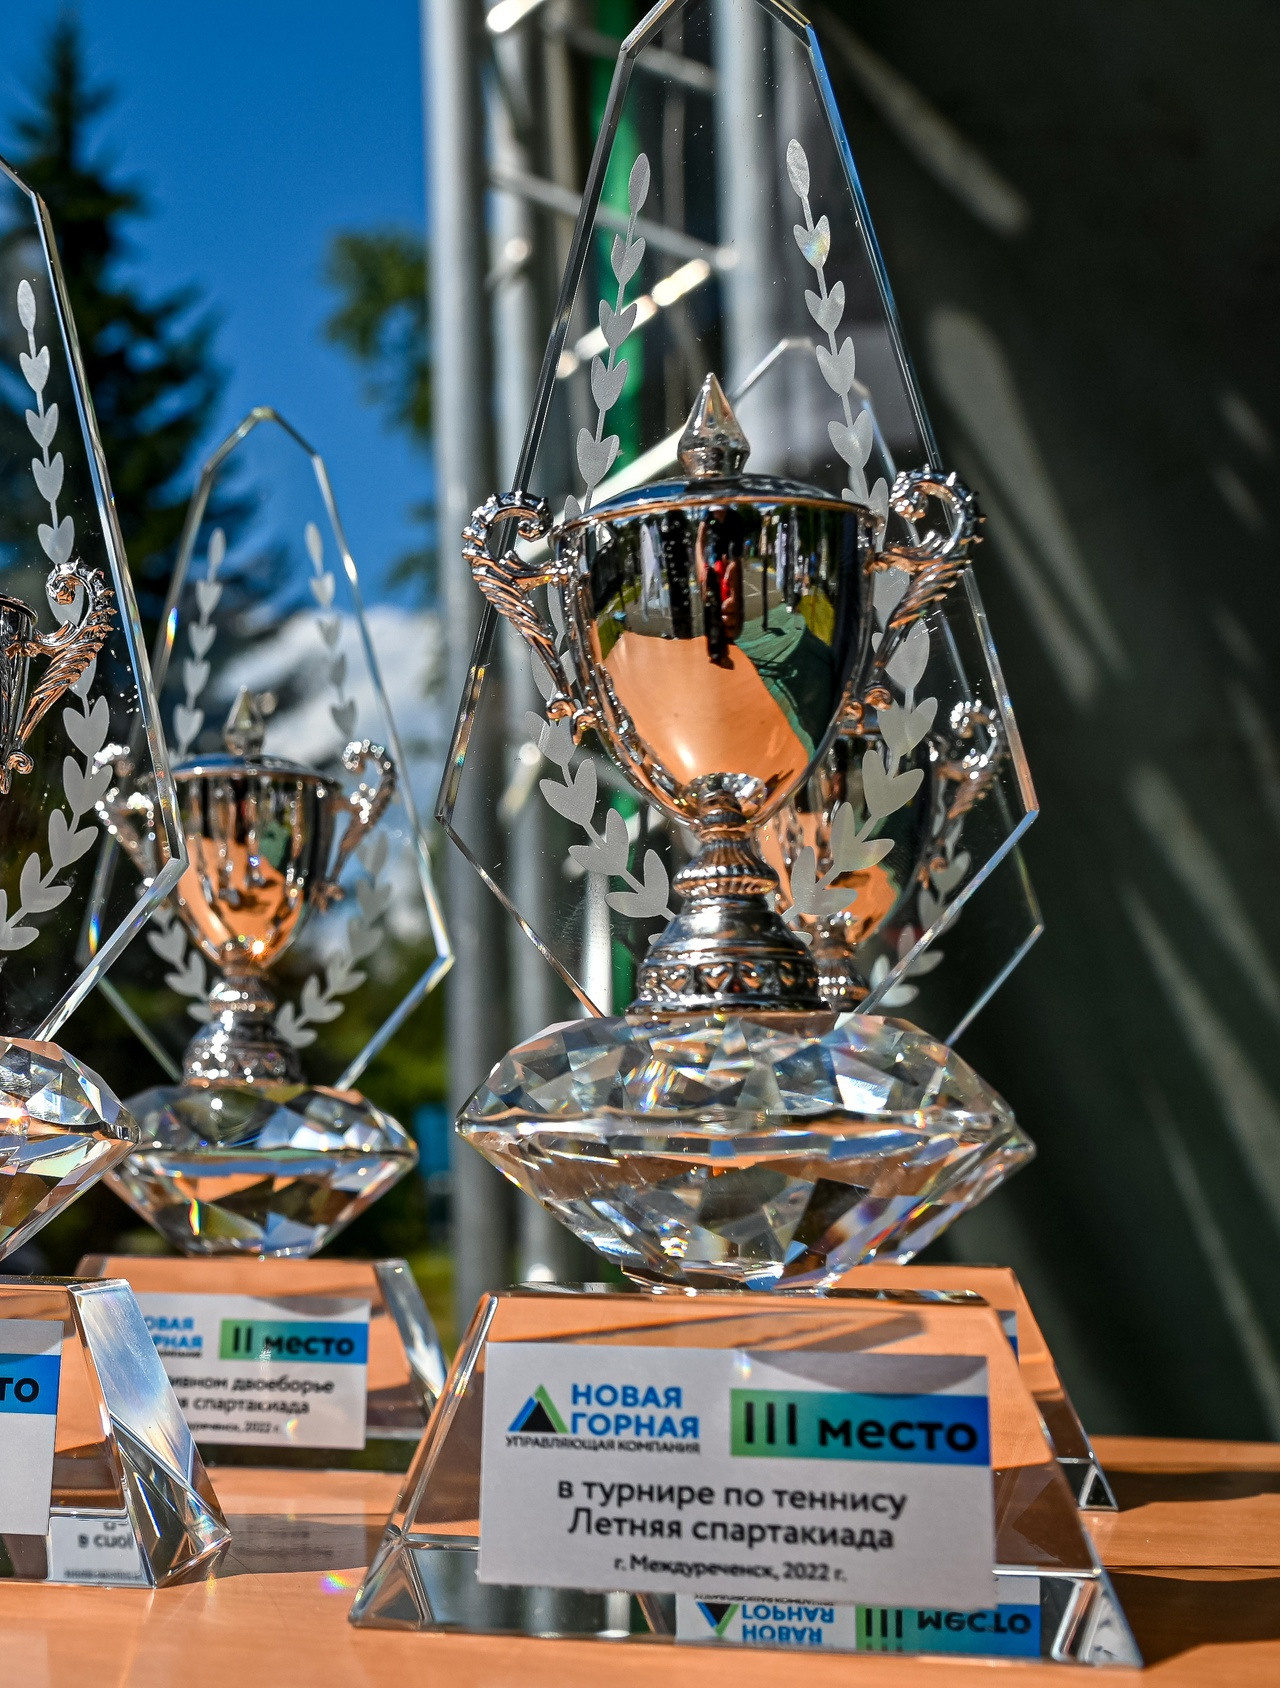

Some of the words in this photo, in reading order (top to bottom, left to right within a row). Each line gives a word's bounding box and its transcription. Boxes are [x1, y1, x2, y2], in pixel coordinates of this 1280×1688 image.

[144, 1316, 195, 1331] ОВАЯ
[152, 1335, 203, 1349] РНАЯ
[265, 1335, 356, 1356] место
[232, 1374, 335, 1396] двоеборье
[571, 1383, 683, 1409] НОВАЯ
[193, 1397, 310, 1415] спартакиада
[569, 1412, 700, 1439] ГОРНАЯ
[744, 1401, 798, 1446] III
[819, 1417, 978, 1452] место
[505, 1435, 617, 1452] УПРАВЛЯЮЩАЯ
[618, 1439, 701, 1455] КОМПАНИЯ
[557, 1481, 573, 1499] в
[582, 1480, 715, 1512] турнире
[724, 1488, 763, 1508] по
[772, 1488, 907, 1520] теннису
[567, 1508, 682, 1541] Летняя
[692, 1521, 894, 1551] спартакиада
[614, 1559, 626, 1571] г.
[630, 1555, 779, 1582] Междуреченск,
[782, 1562, 829, 1581] 2022
[833, 1567, 847, 1583] г.
